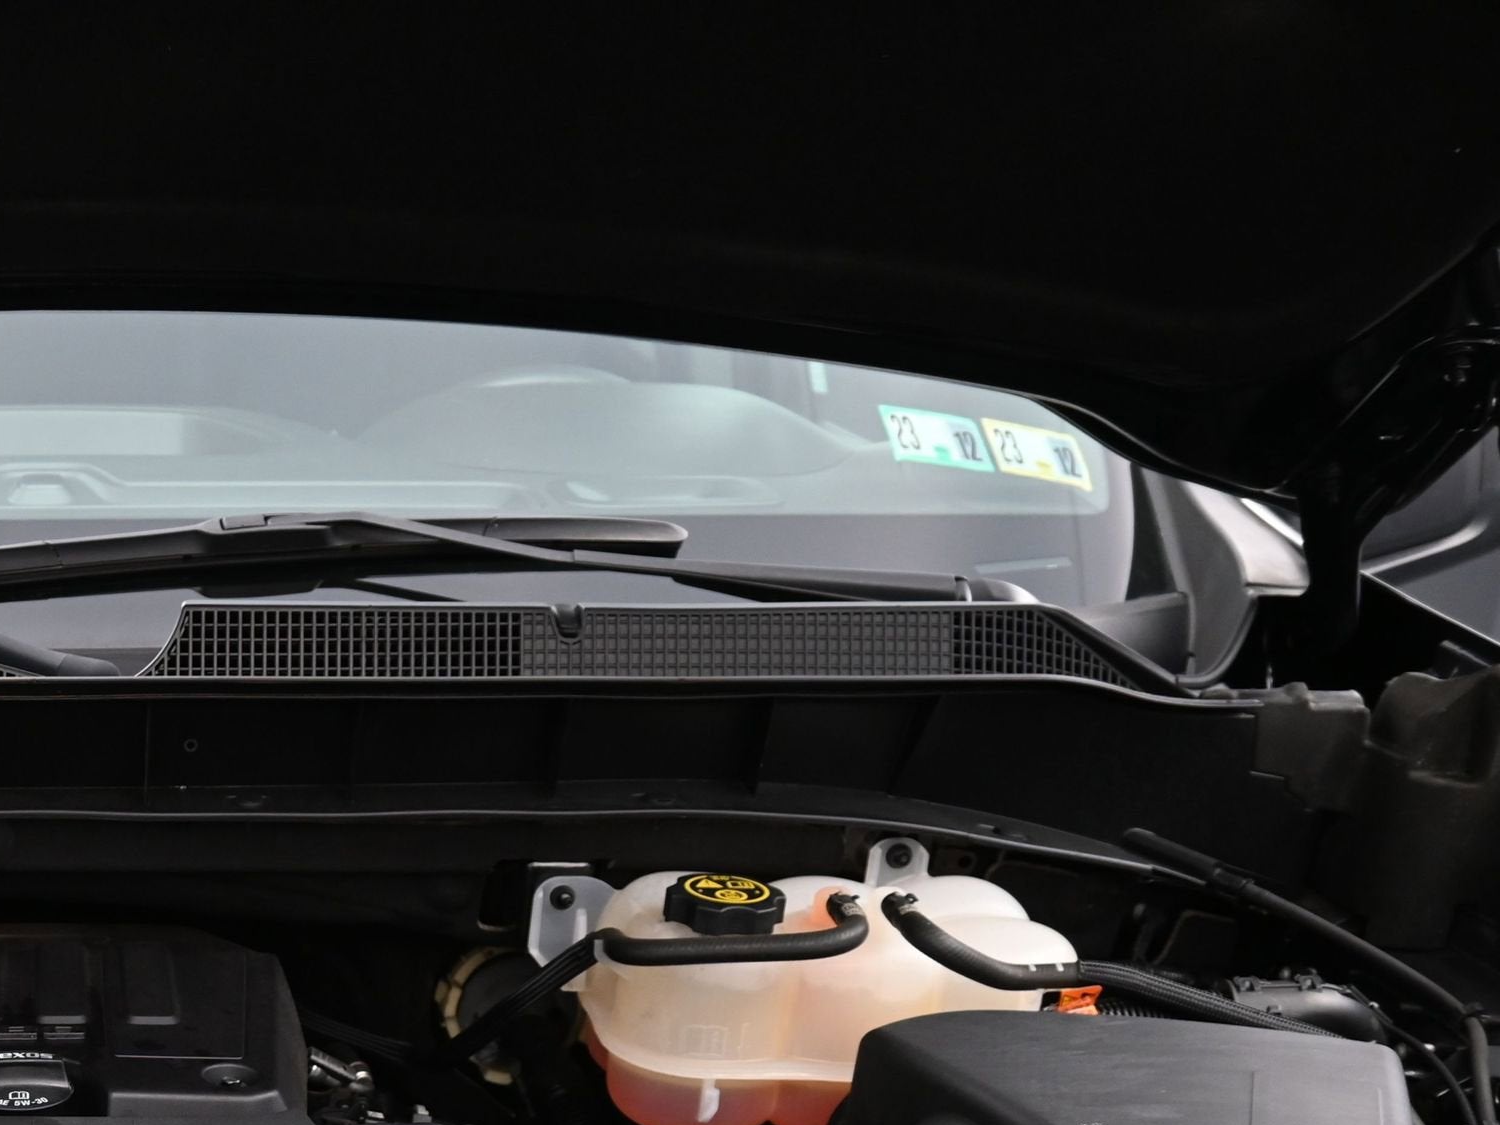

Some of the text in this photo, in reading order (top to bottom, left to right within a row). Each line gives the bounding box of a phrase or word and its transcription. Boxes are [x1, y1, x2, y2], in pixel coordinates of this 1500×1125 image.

[890, 414, 984, 463] 23 12
[993, 428, 1083, 479] 23 12
[14, 1096, 48, 1106] 5W-30
